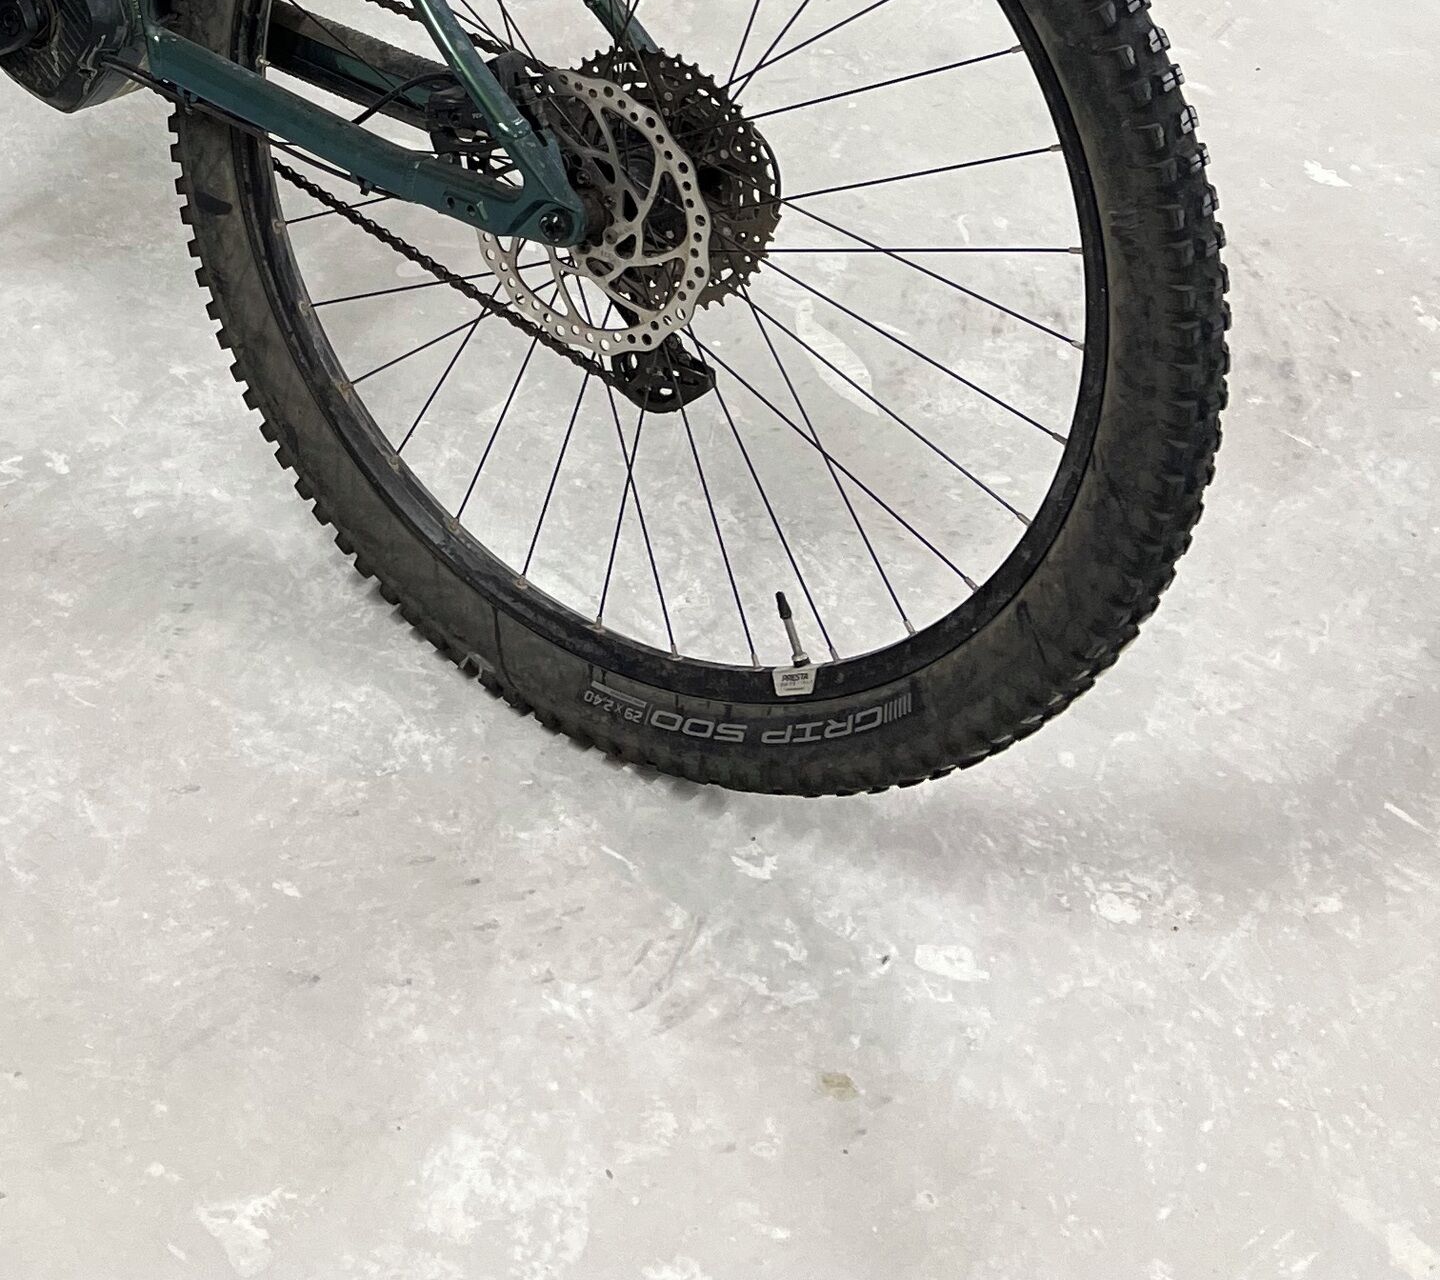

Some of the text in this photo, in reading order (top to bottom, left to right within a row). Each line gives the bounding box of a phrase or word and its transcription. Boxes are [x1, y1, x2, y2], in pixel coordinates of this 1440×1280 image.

[624, 707, 643, 723] 29
[650, 706, 883, 744] GRIP 500
